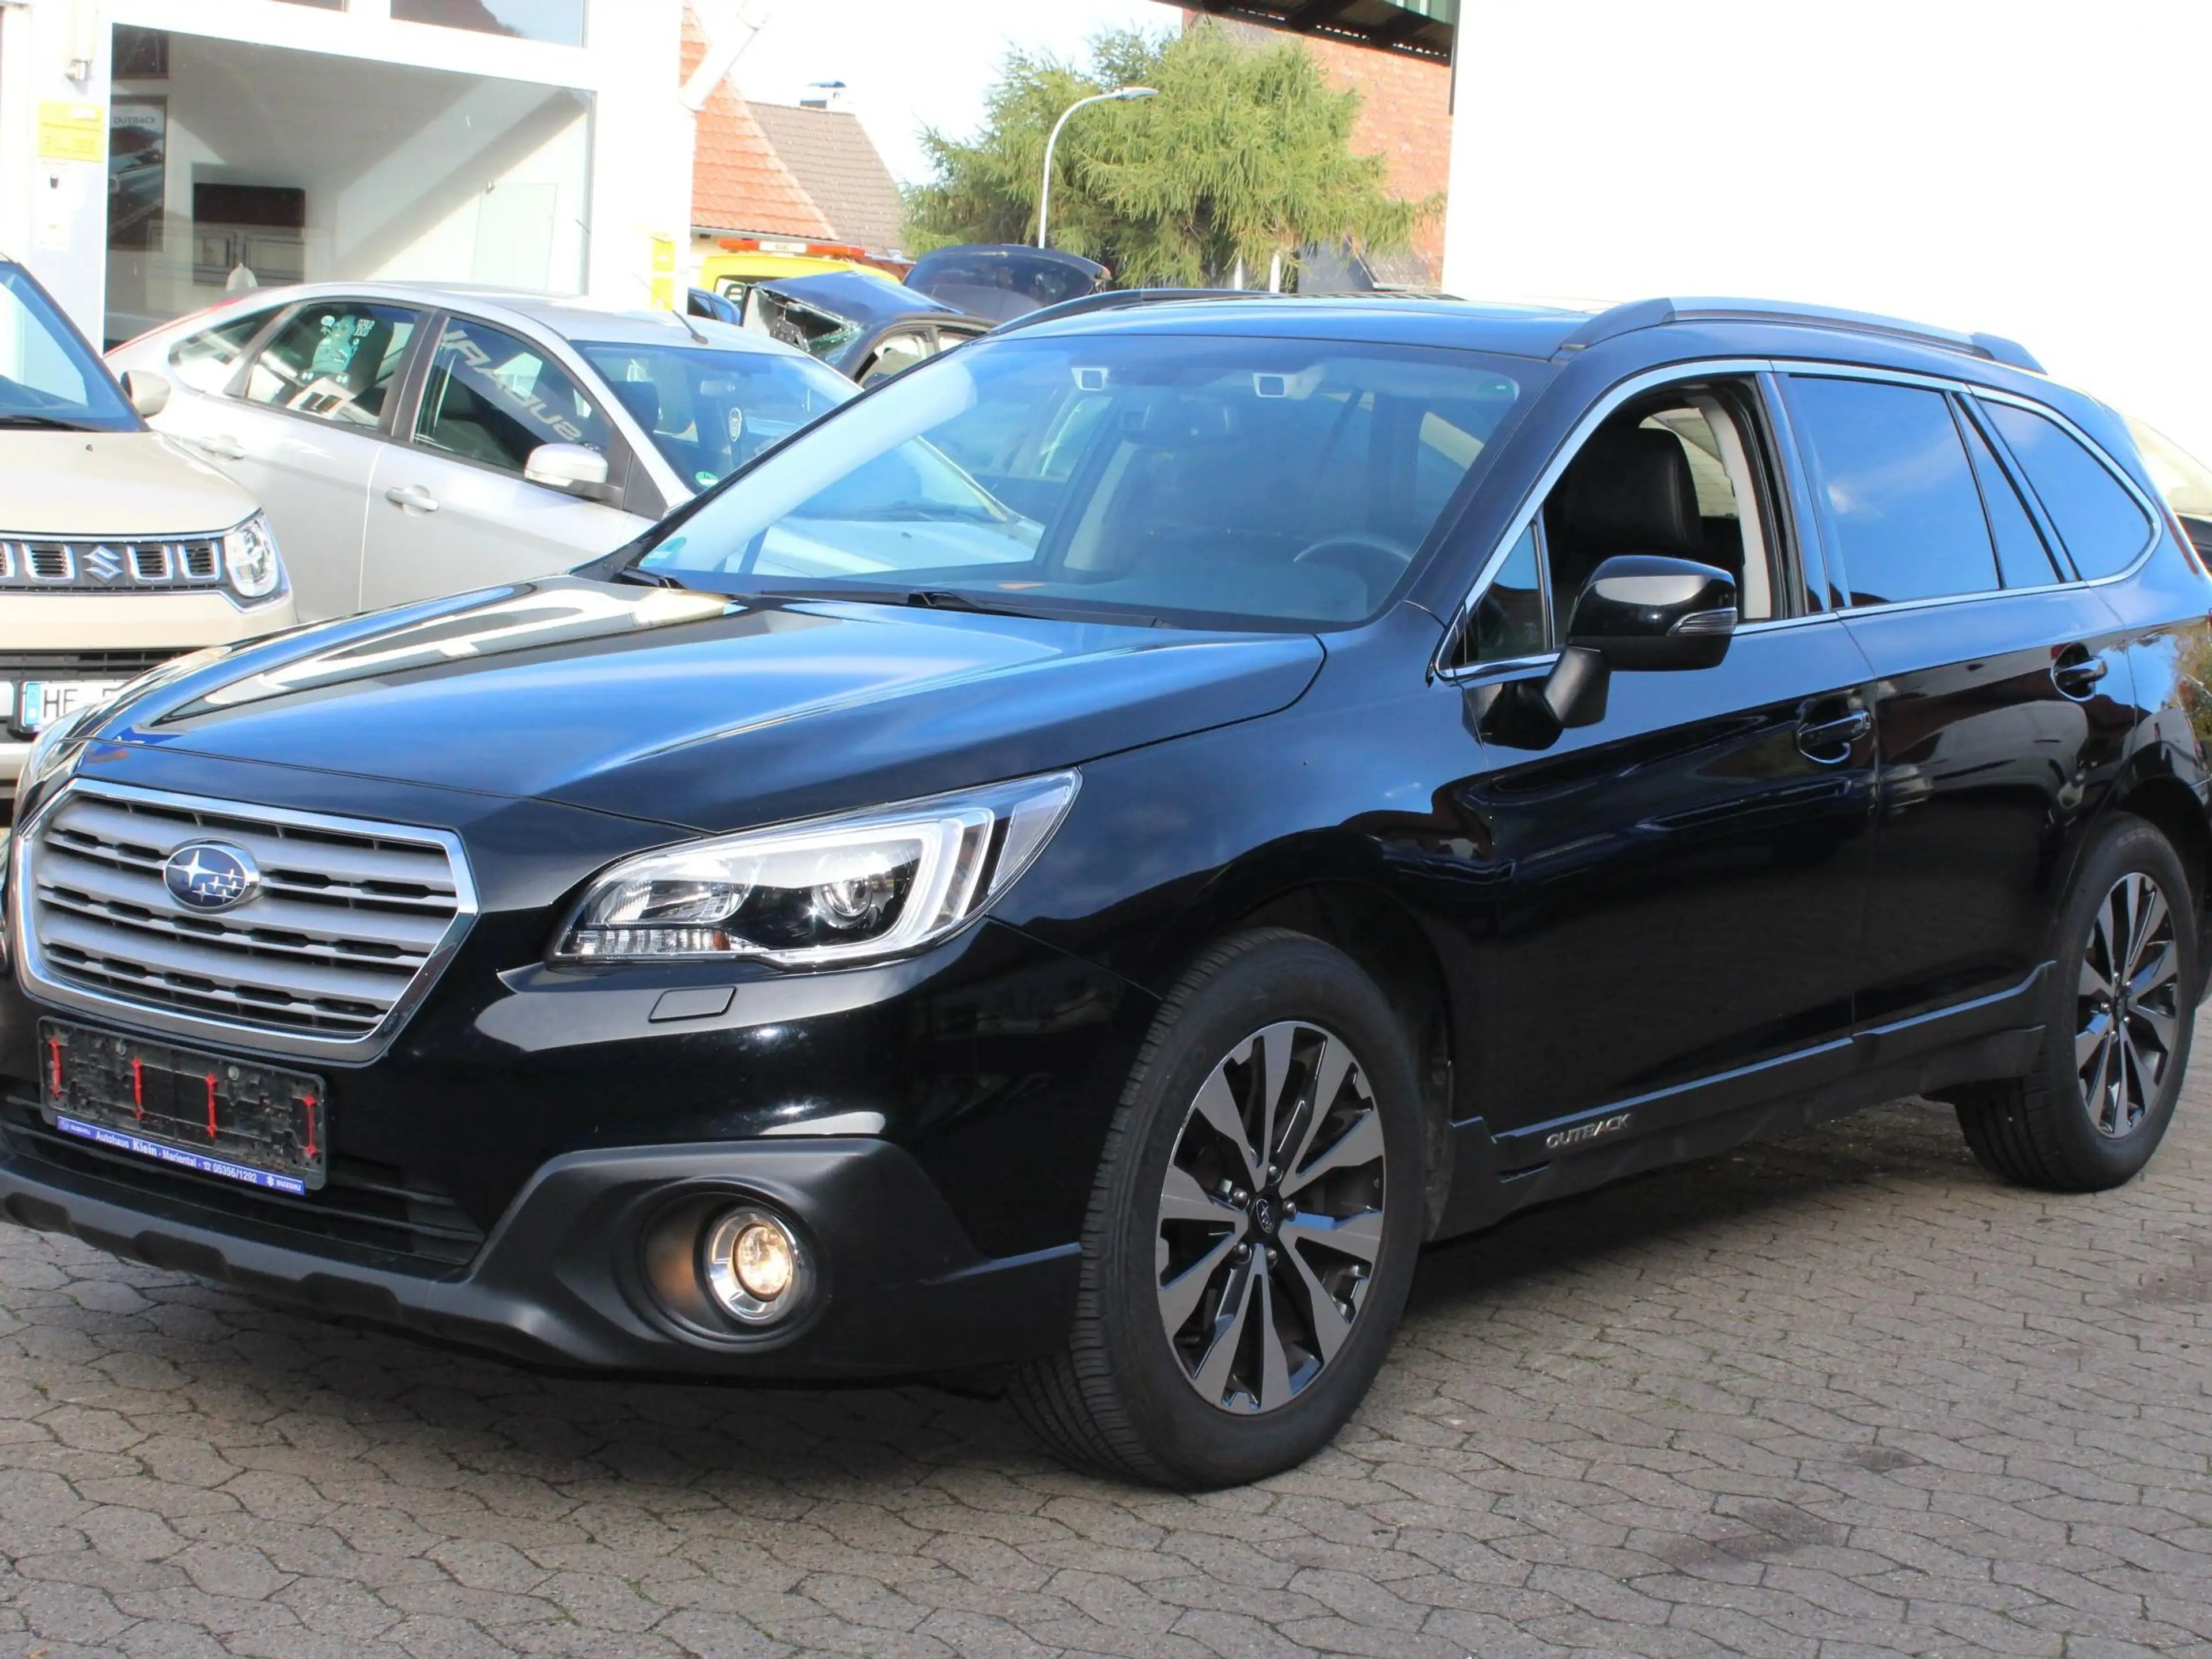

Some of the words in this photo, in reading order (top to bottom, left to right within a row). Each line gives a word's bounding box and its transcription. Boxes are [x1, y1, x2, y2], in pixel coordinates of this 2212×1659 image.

[1546, 1113, 1632, 1148] OUTBACK
[96, 1131, 130, 1148] Autohaus
[133, 1139, 157, 1156] Klein
[162, 1149, 196, 1168] Mariental
